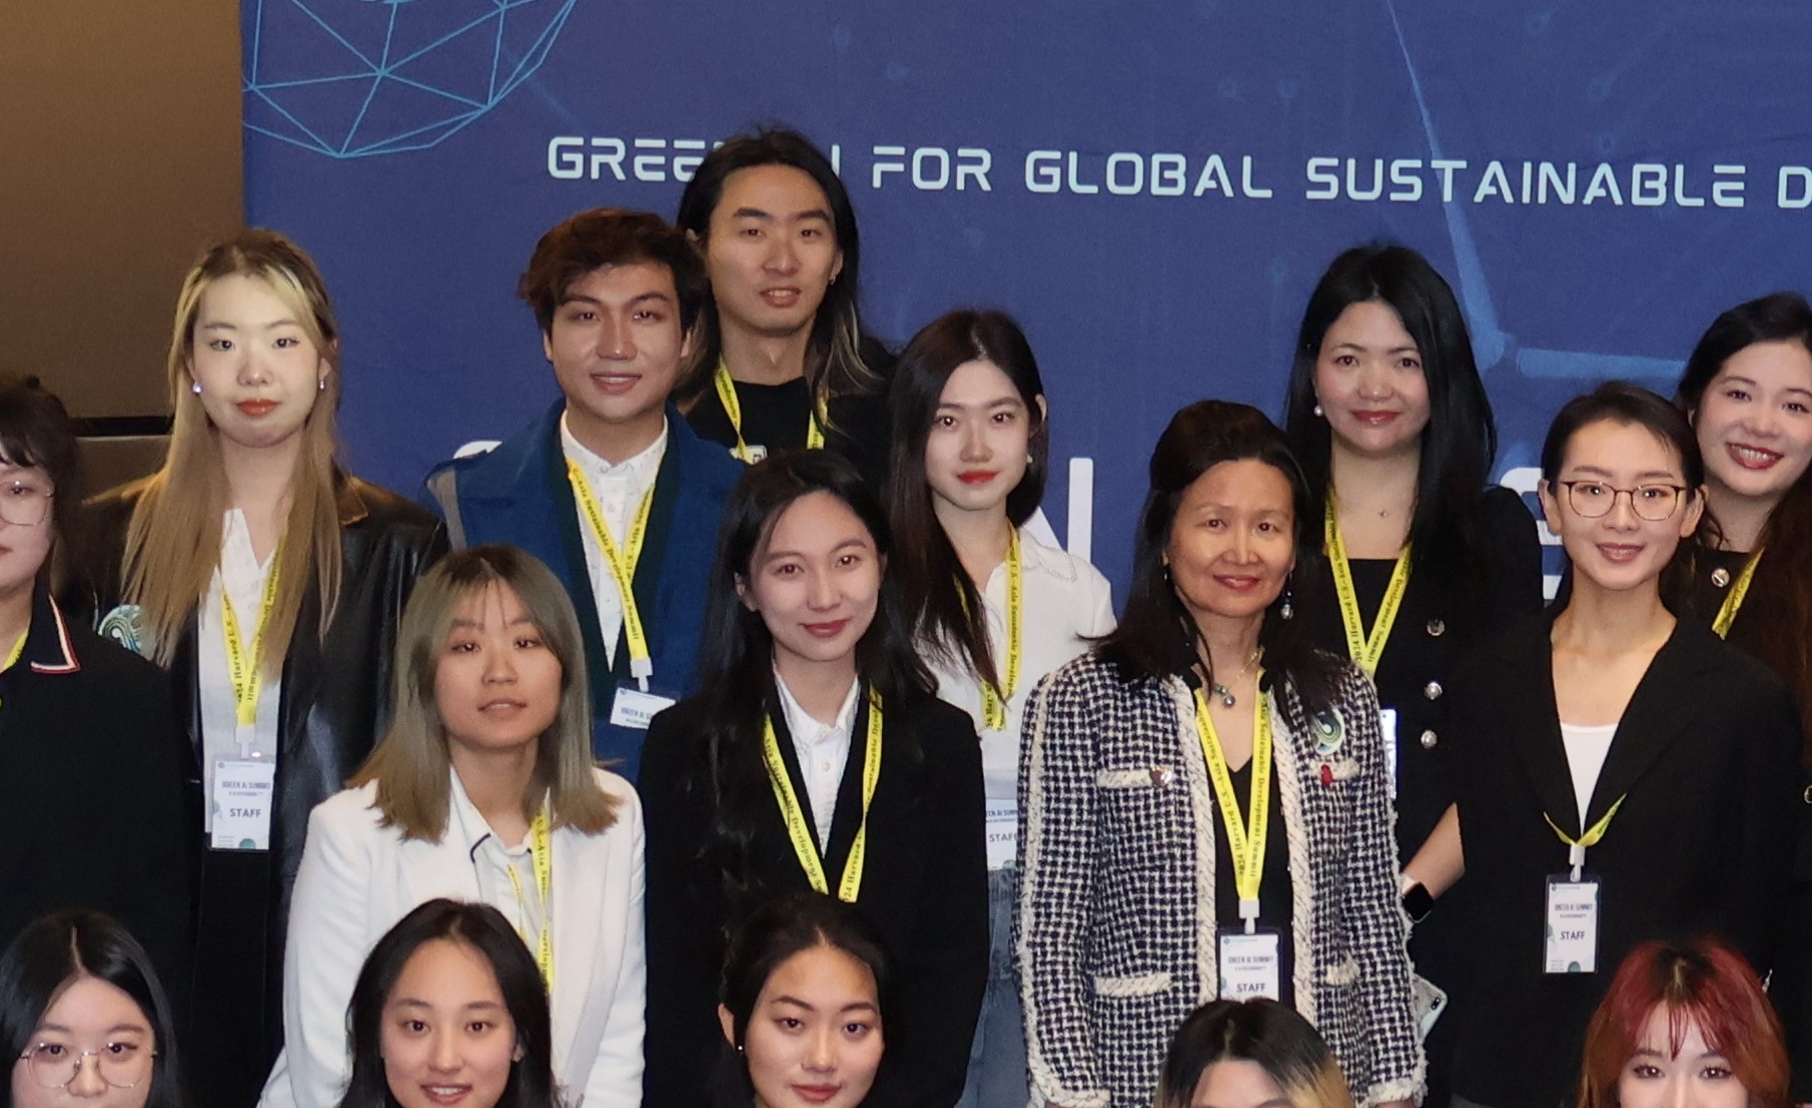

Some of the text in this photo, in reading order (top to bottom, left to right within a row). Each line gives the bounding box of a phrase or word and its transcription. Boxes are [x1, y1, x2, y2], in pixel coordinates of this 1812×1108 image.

[872, 145, 992, 191] FOR
[1025, 150, 1273, 198] GLOBAL
[1306, 157, 1746, 208] SUSTAINABLE
[586, 499, 609, 546] Sustainable
[229, 807, 262, 819] STAFF
[1250, 718, 1267, 878] Sustainable Development Summit
[791, 816, 817, 878] Development
[1560, 931, 1586, 941] STAFF
[1236, 983, 1267, 993] STAFF
